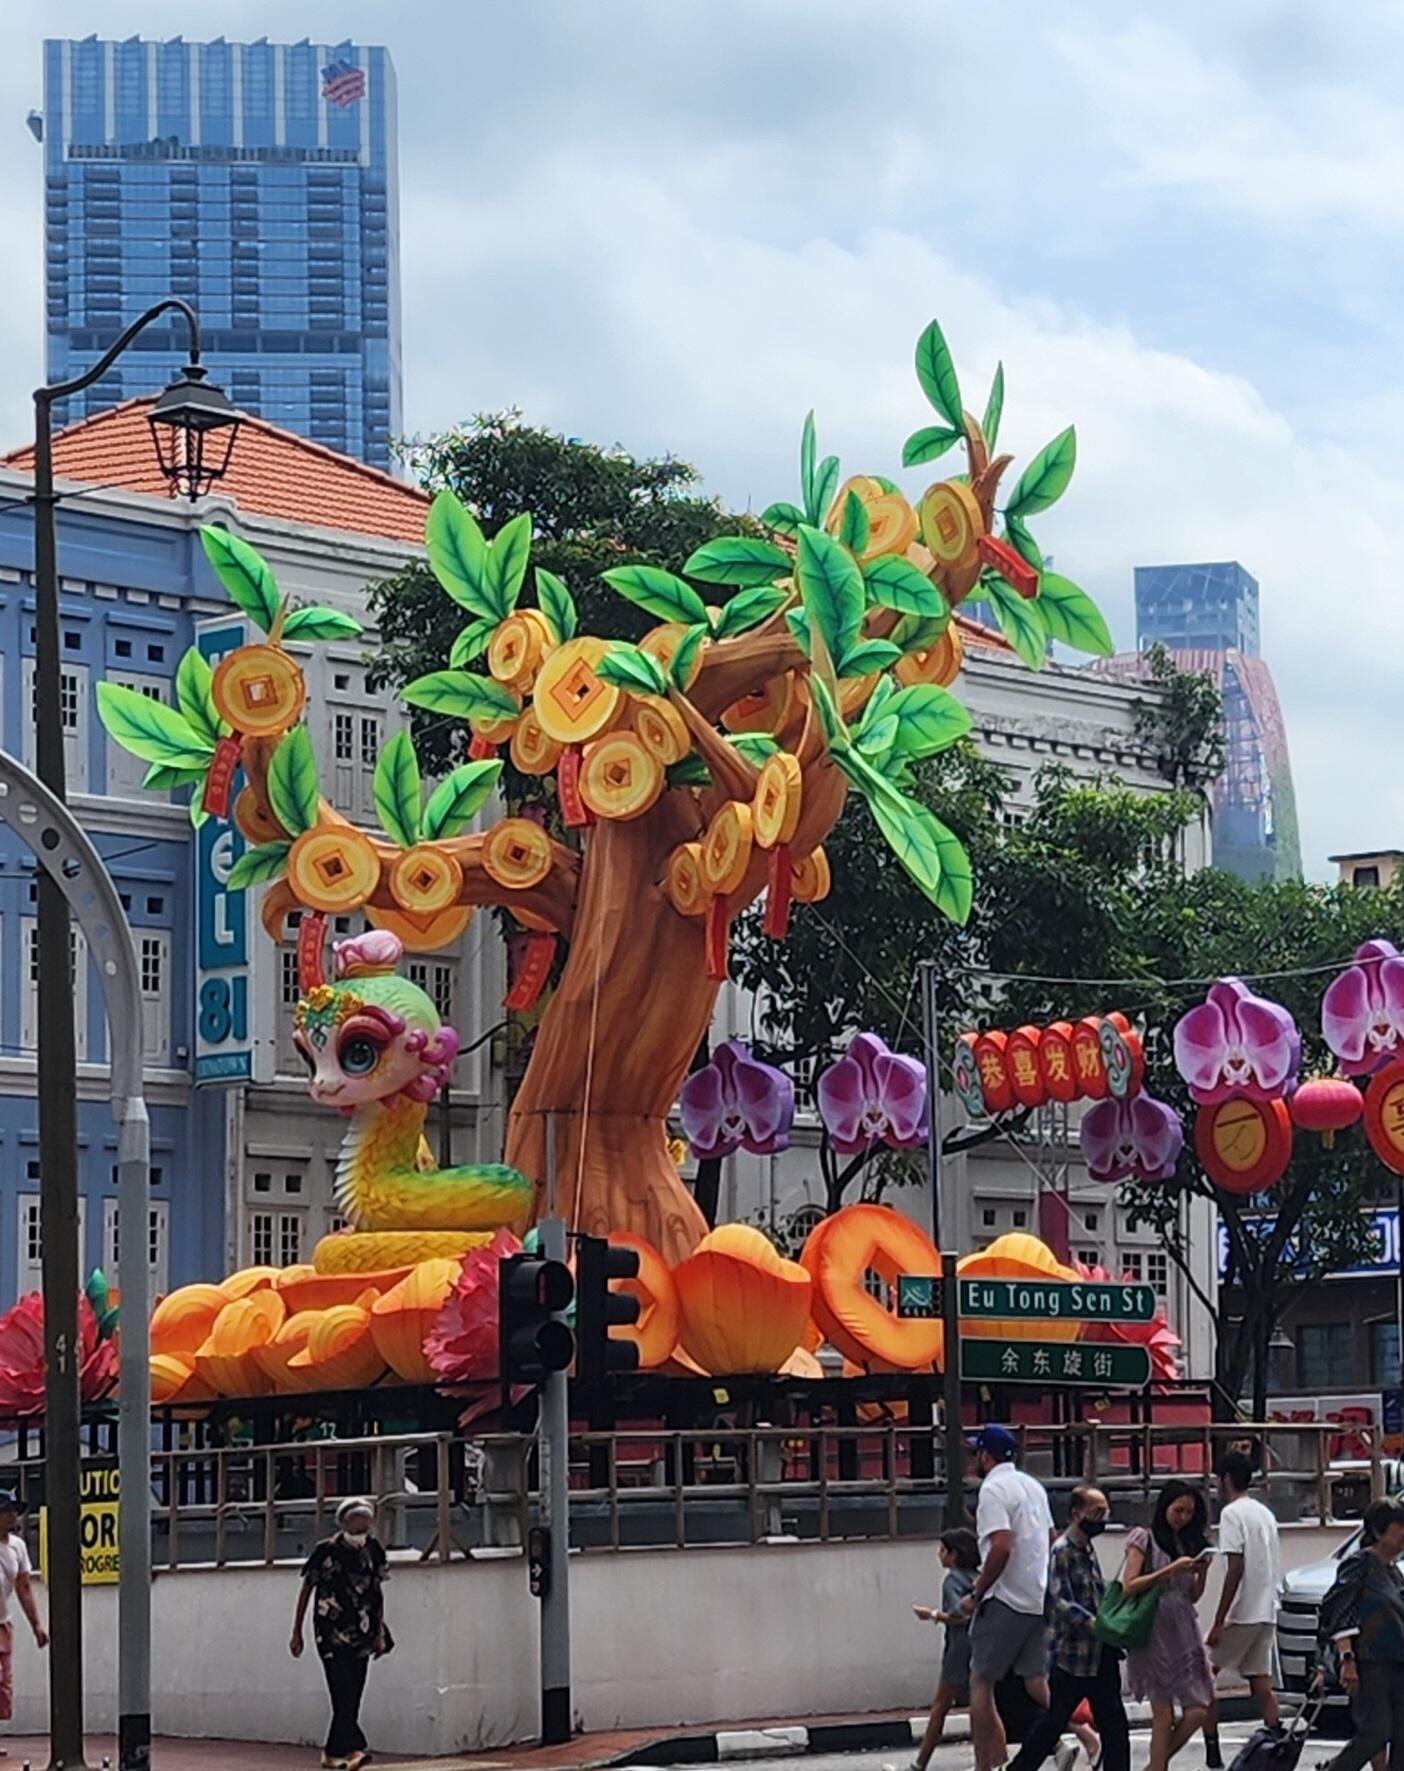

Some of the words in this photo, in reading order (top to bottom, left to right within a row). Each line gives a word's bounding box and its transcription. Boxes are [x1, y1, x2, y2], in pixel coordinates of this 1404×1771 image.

[200, 975, 248, 1044] 81
[981, 1040, 1100, 1090] 恭喜发财
[968, 1282, 995, 1308] Eu
[1006, 1284, 1060, 1316] Tong
[1072, 1286, 1112, 1312] Sen
[1122, 1287, 1145, 1313] St
[1001, 1347, 1113, 1378] 余东旋街
